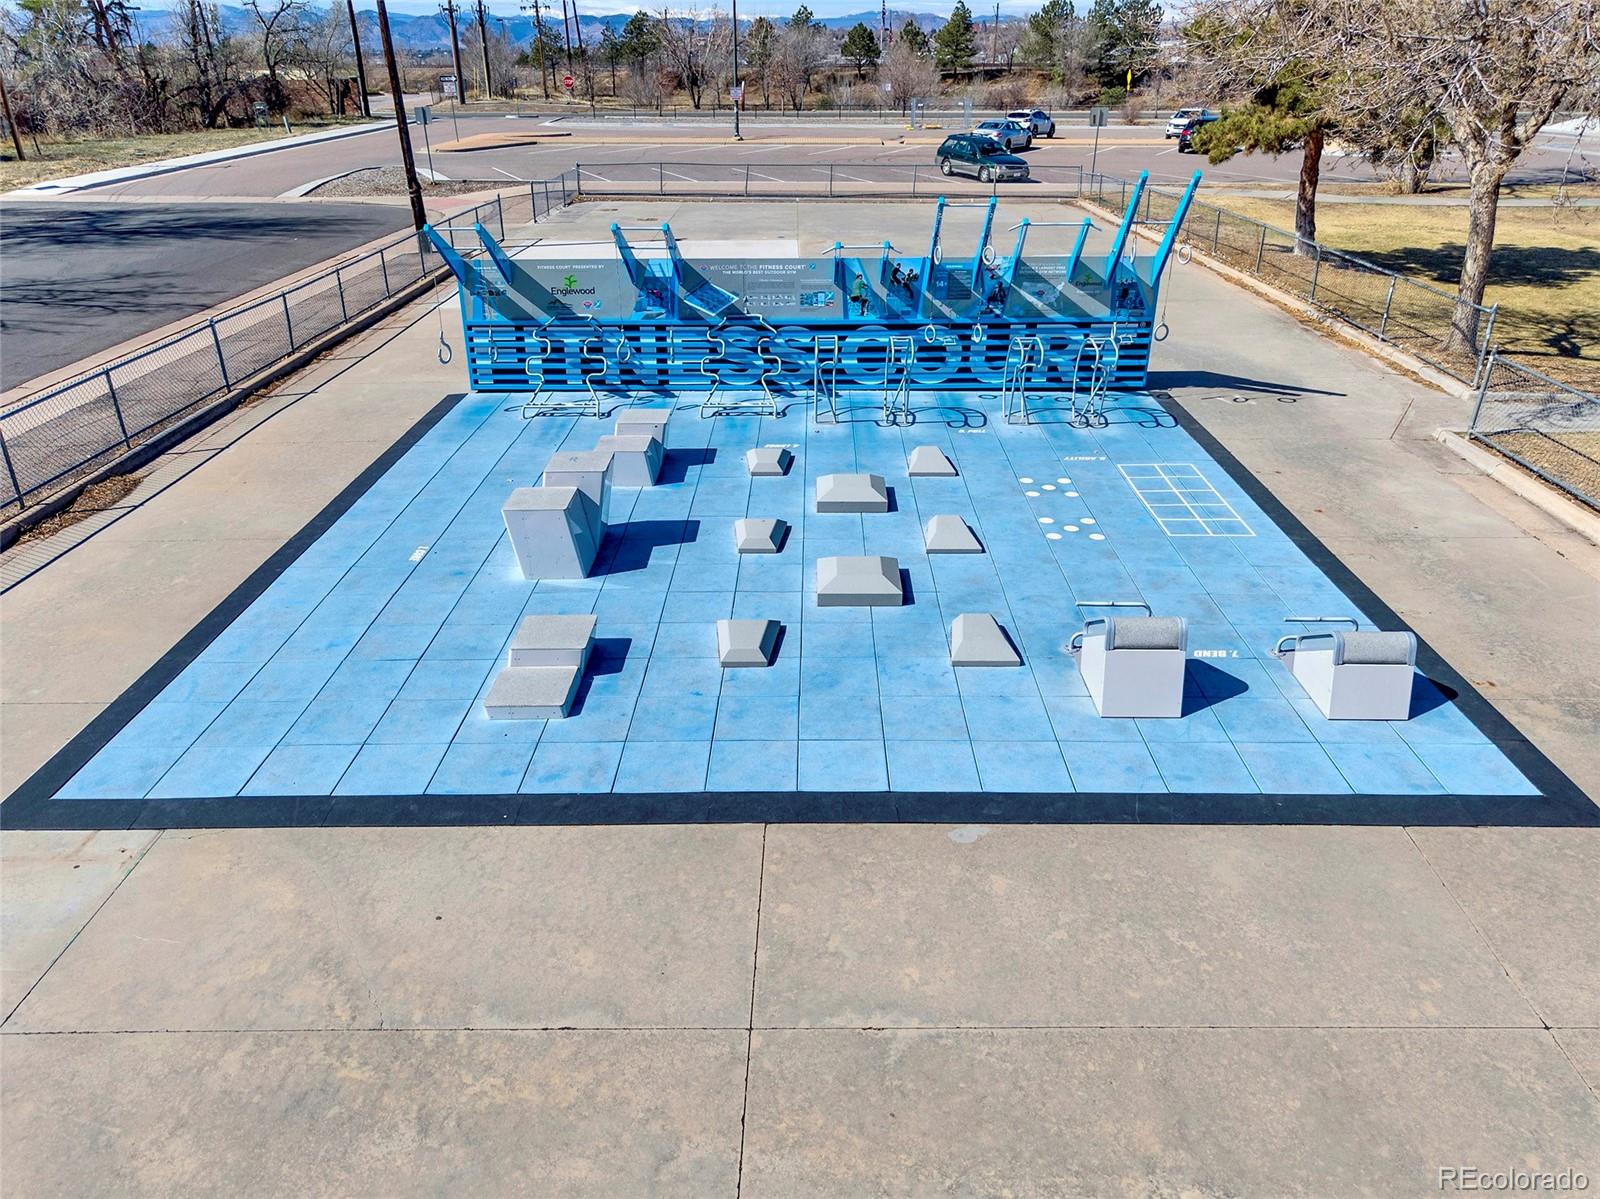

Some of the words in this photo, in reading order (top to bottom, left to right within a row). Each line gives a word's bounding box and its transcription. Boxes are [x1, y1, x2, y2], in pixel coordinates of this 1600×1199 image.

[551, 286, 596, 297] Englewood
[1193, 649, 1227, 658] BEND
[1229, 649, 1239, 658] 7.
